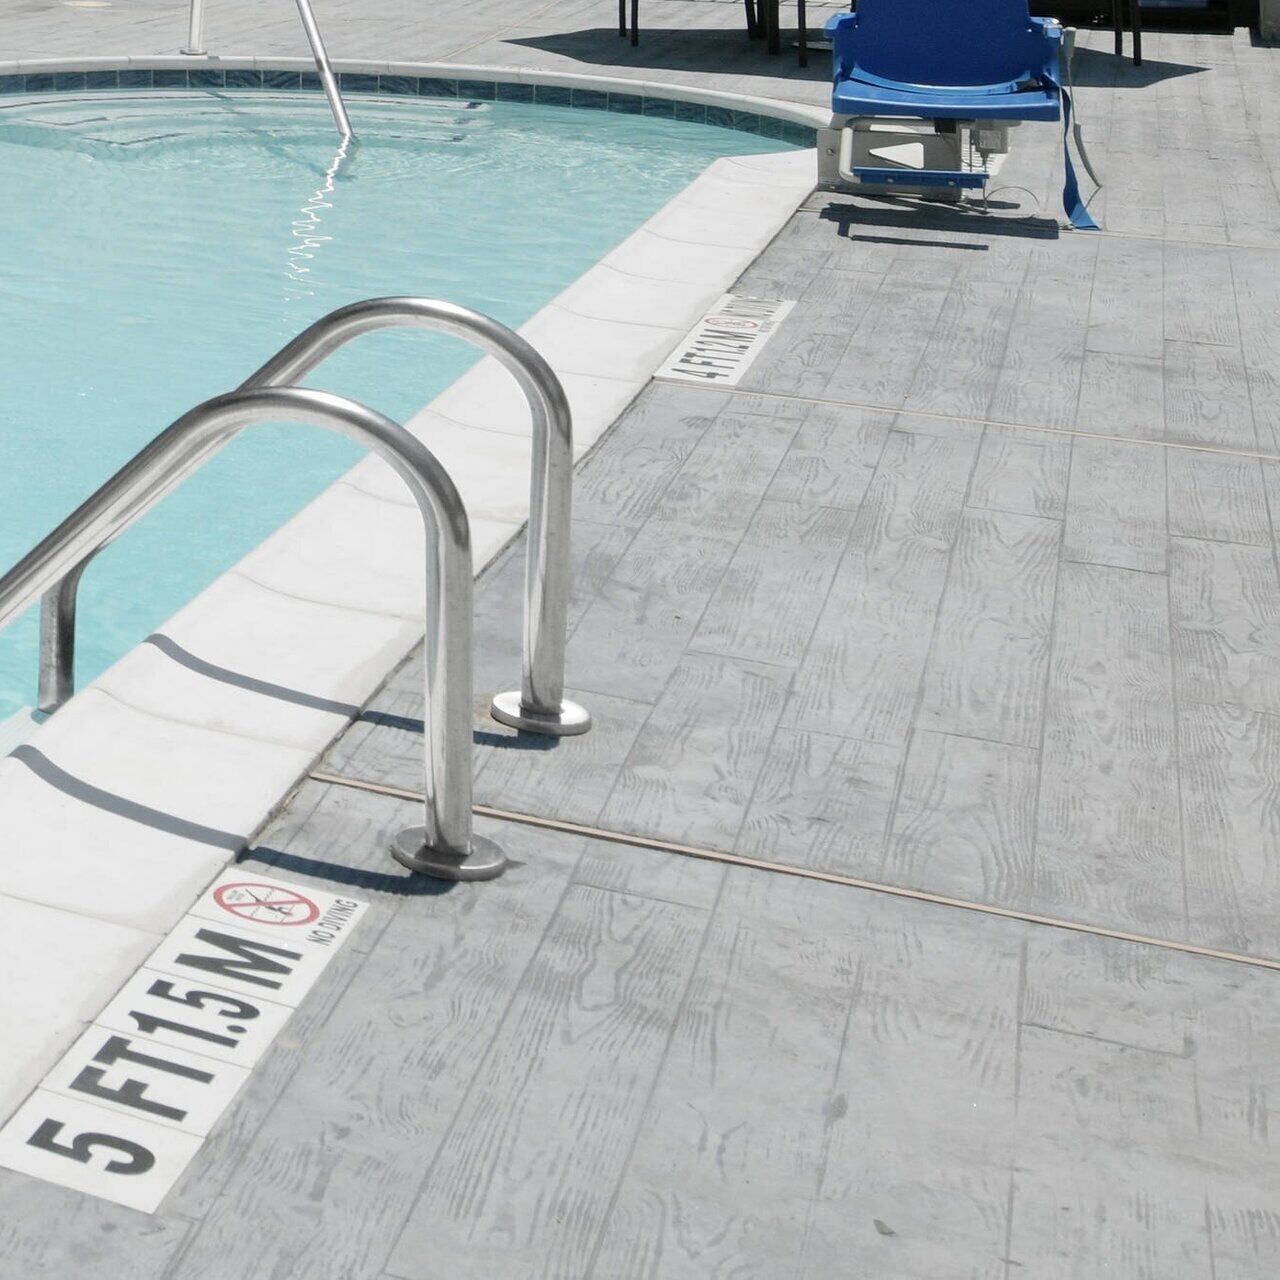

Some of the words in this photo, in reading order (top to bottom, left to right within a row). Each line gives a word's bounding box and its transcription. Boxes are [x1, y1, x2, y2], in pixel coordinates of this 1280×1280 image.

[305, 929, 336, 946] NO
[319, 898, 359, 932] DIVING
[174, 928, 304, 990] M
[127, 979, 261, 1049] 1.5
[68, 1035, 216, 1122] FT
[26, 1118, 156, 1175] 5
